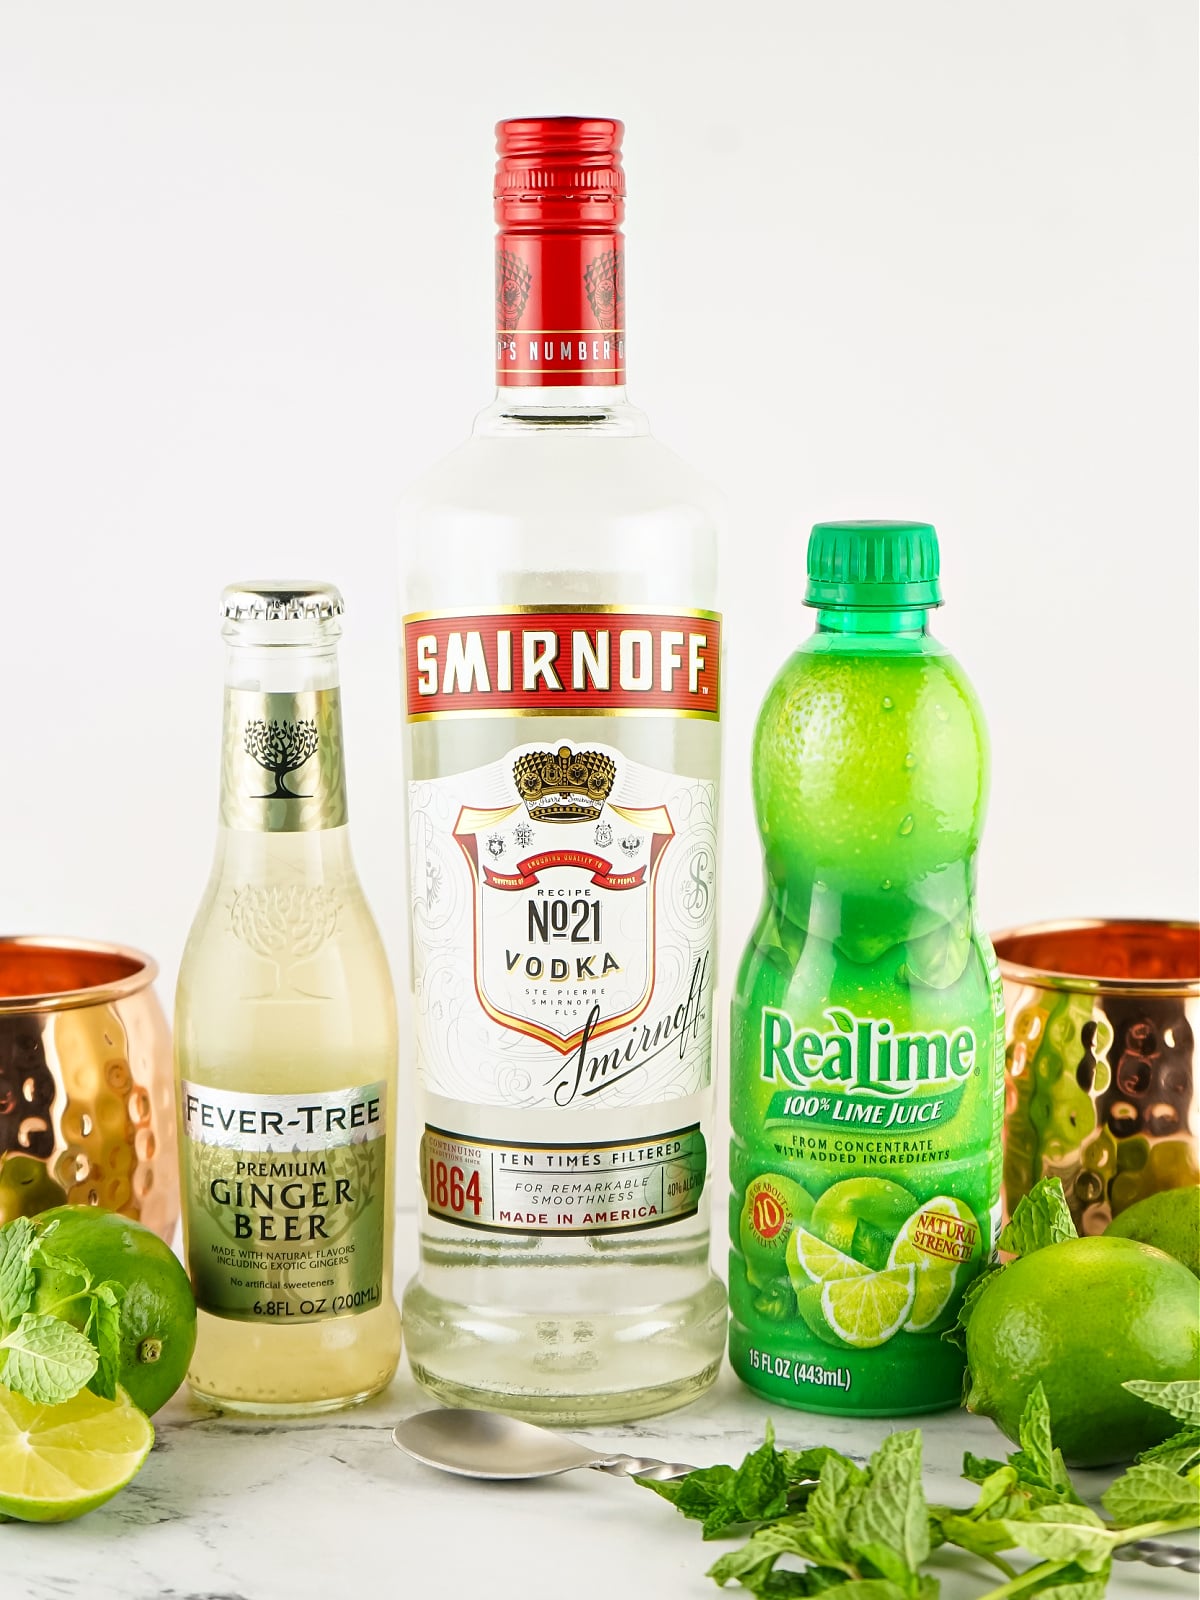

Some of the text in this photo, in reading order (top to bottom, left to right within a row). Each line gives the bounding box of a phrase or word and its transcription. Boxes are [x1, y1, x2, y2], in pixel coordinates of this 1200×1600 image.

[529, 341, 610, 360] NUMBER
[416, 629, 708, 695] SMIRNOFF
[537, 889, 592, 897] RECIPE
[505, 949, 623, 982] VODKA
[557, 988, 606, 996] PIERRE
[543, 950, 711, 1106] Smirnoff
[186, 1094, 380, 1136] FEVER-TREE
[783, 1096, 944, 1128] 100% LIME JUICE
[429, 1137, 482, 1158] CONTINUING
[500, 1142, 682, 1168] TEN TIMES FILTERED
[774, 1143, 950, 1165] WITH ADDED INGREDIENTS
[792, 1135, 933, 1153] FROM CONCENTRATE
[236, 1161, 327, 1177] PREMIUM
[210, 1178, 355, 1210] GINGER
[429, 1158, 483, 1216] 1864
[515, 1177, 650, 1194] FOR REMARKABLE
[531, 1191, 634, 1205] SMOOTHNESS
[234, 1213, 330, 1242] BEER
[499, 1205, 658, 1225] MADE IN AMERICA
[755, 1198, 780, 1232] 10
[916, 1212, 977, 1246] NATURAL
[211, 1244, 356, 1261] MADE WITH NATURAL FLAVORS
[913, 1231, 973, 1260] STRENGTH
[217, 1255, 349, 1271] INCLUDING EXOTIC GINGERS
[230, 1277, 335, 1289] No artificial sweeteners
[253, 1283, 380, 1317] 6.8FL OZ (200ML)
[750, 1348, 852, 1391] 15 FL OZ (443mL)
